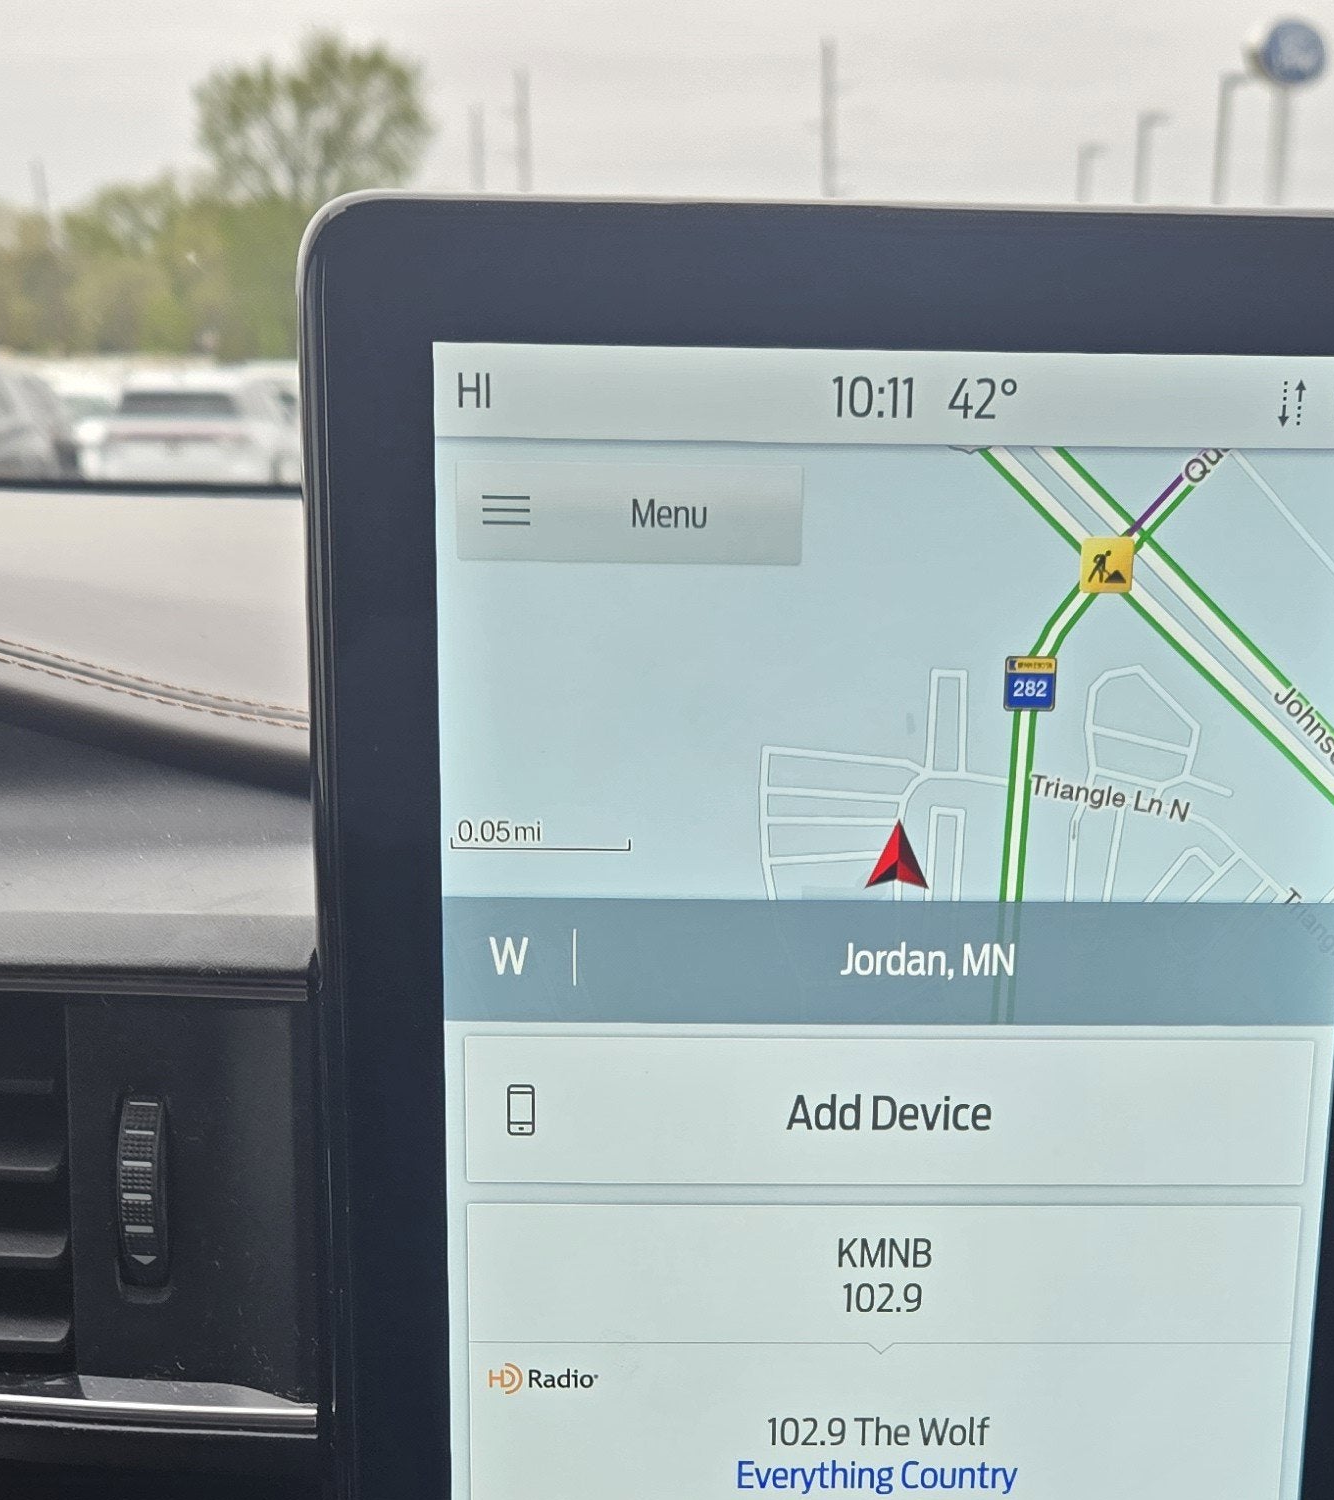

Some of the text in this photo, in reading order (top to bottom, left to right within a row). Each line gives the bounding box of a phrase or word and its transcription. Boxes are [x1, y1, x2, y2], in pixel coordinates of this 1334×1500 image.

[457, 372, 491, 409] HI
[832, 375, 914, 419] 10:11
[1185, 448, 1230, 483] Qu
[631, 498, 708, 530] Menu
[1013, 679, 1047, 698] 282
[1032, 774, 1190, 822] Triangle Ln N
[457, 819, 542, 842] 0.05 mi
[489, 936, 529, 976] W
[840, 941, 1015, 981] Jordan, MN
[785, 1093, 992, 1133] Add Device
[837, 1237, 932, 1269] KMNB
[842, 1282, 923, 1314] 102.9
[528, 1368, 595, 1389] Radio
[767, 1416, 991, 1447] 102.9 The Wolf
[736, 1459, 1019, 1495] Everything Country
